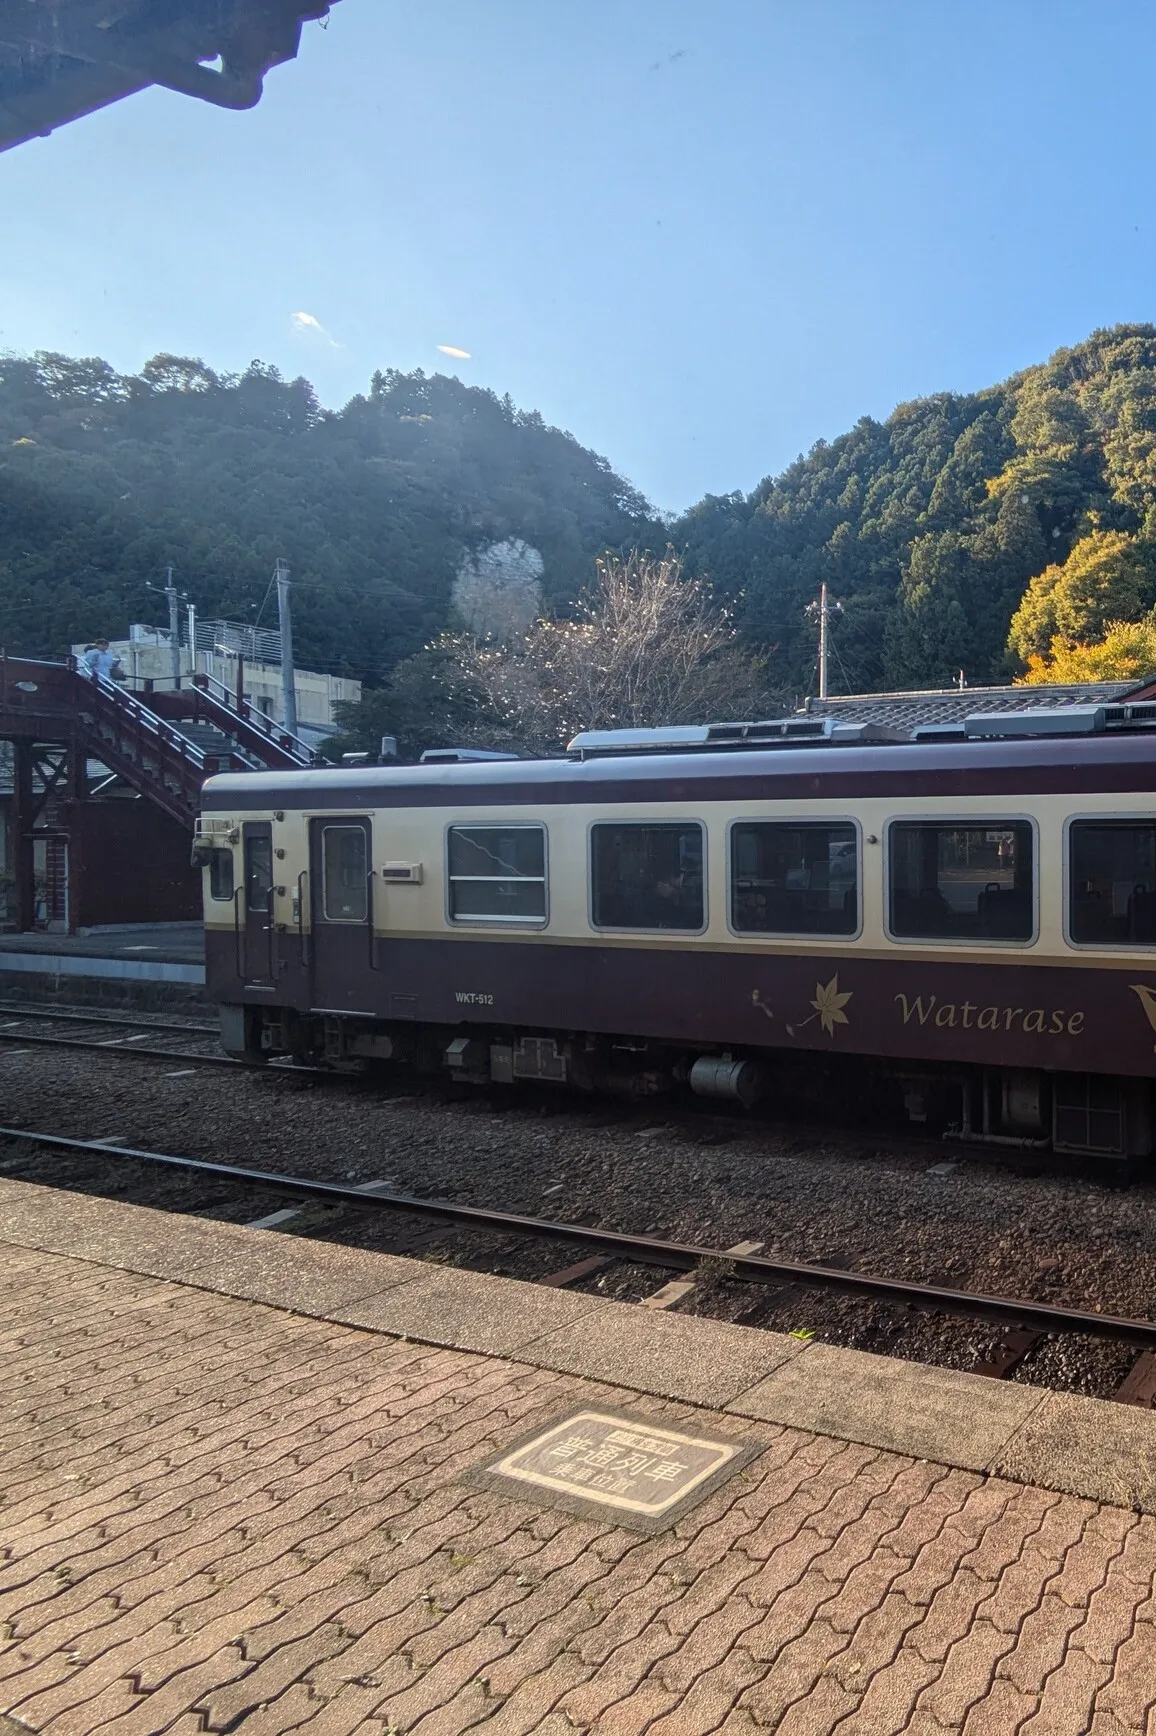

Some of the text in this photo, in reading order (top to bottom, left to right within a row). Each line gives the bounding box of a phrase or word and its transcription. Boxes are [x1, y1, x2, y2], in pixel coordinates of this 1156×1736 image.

[455, 992, 494, 1005] WKT-512
[894, 993, 1085, 1035] Watarase
[548, 1436, 689, 1482] 普通列車
[548, 1462, 637, 1494] 乗車位置
